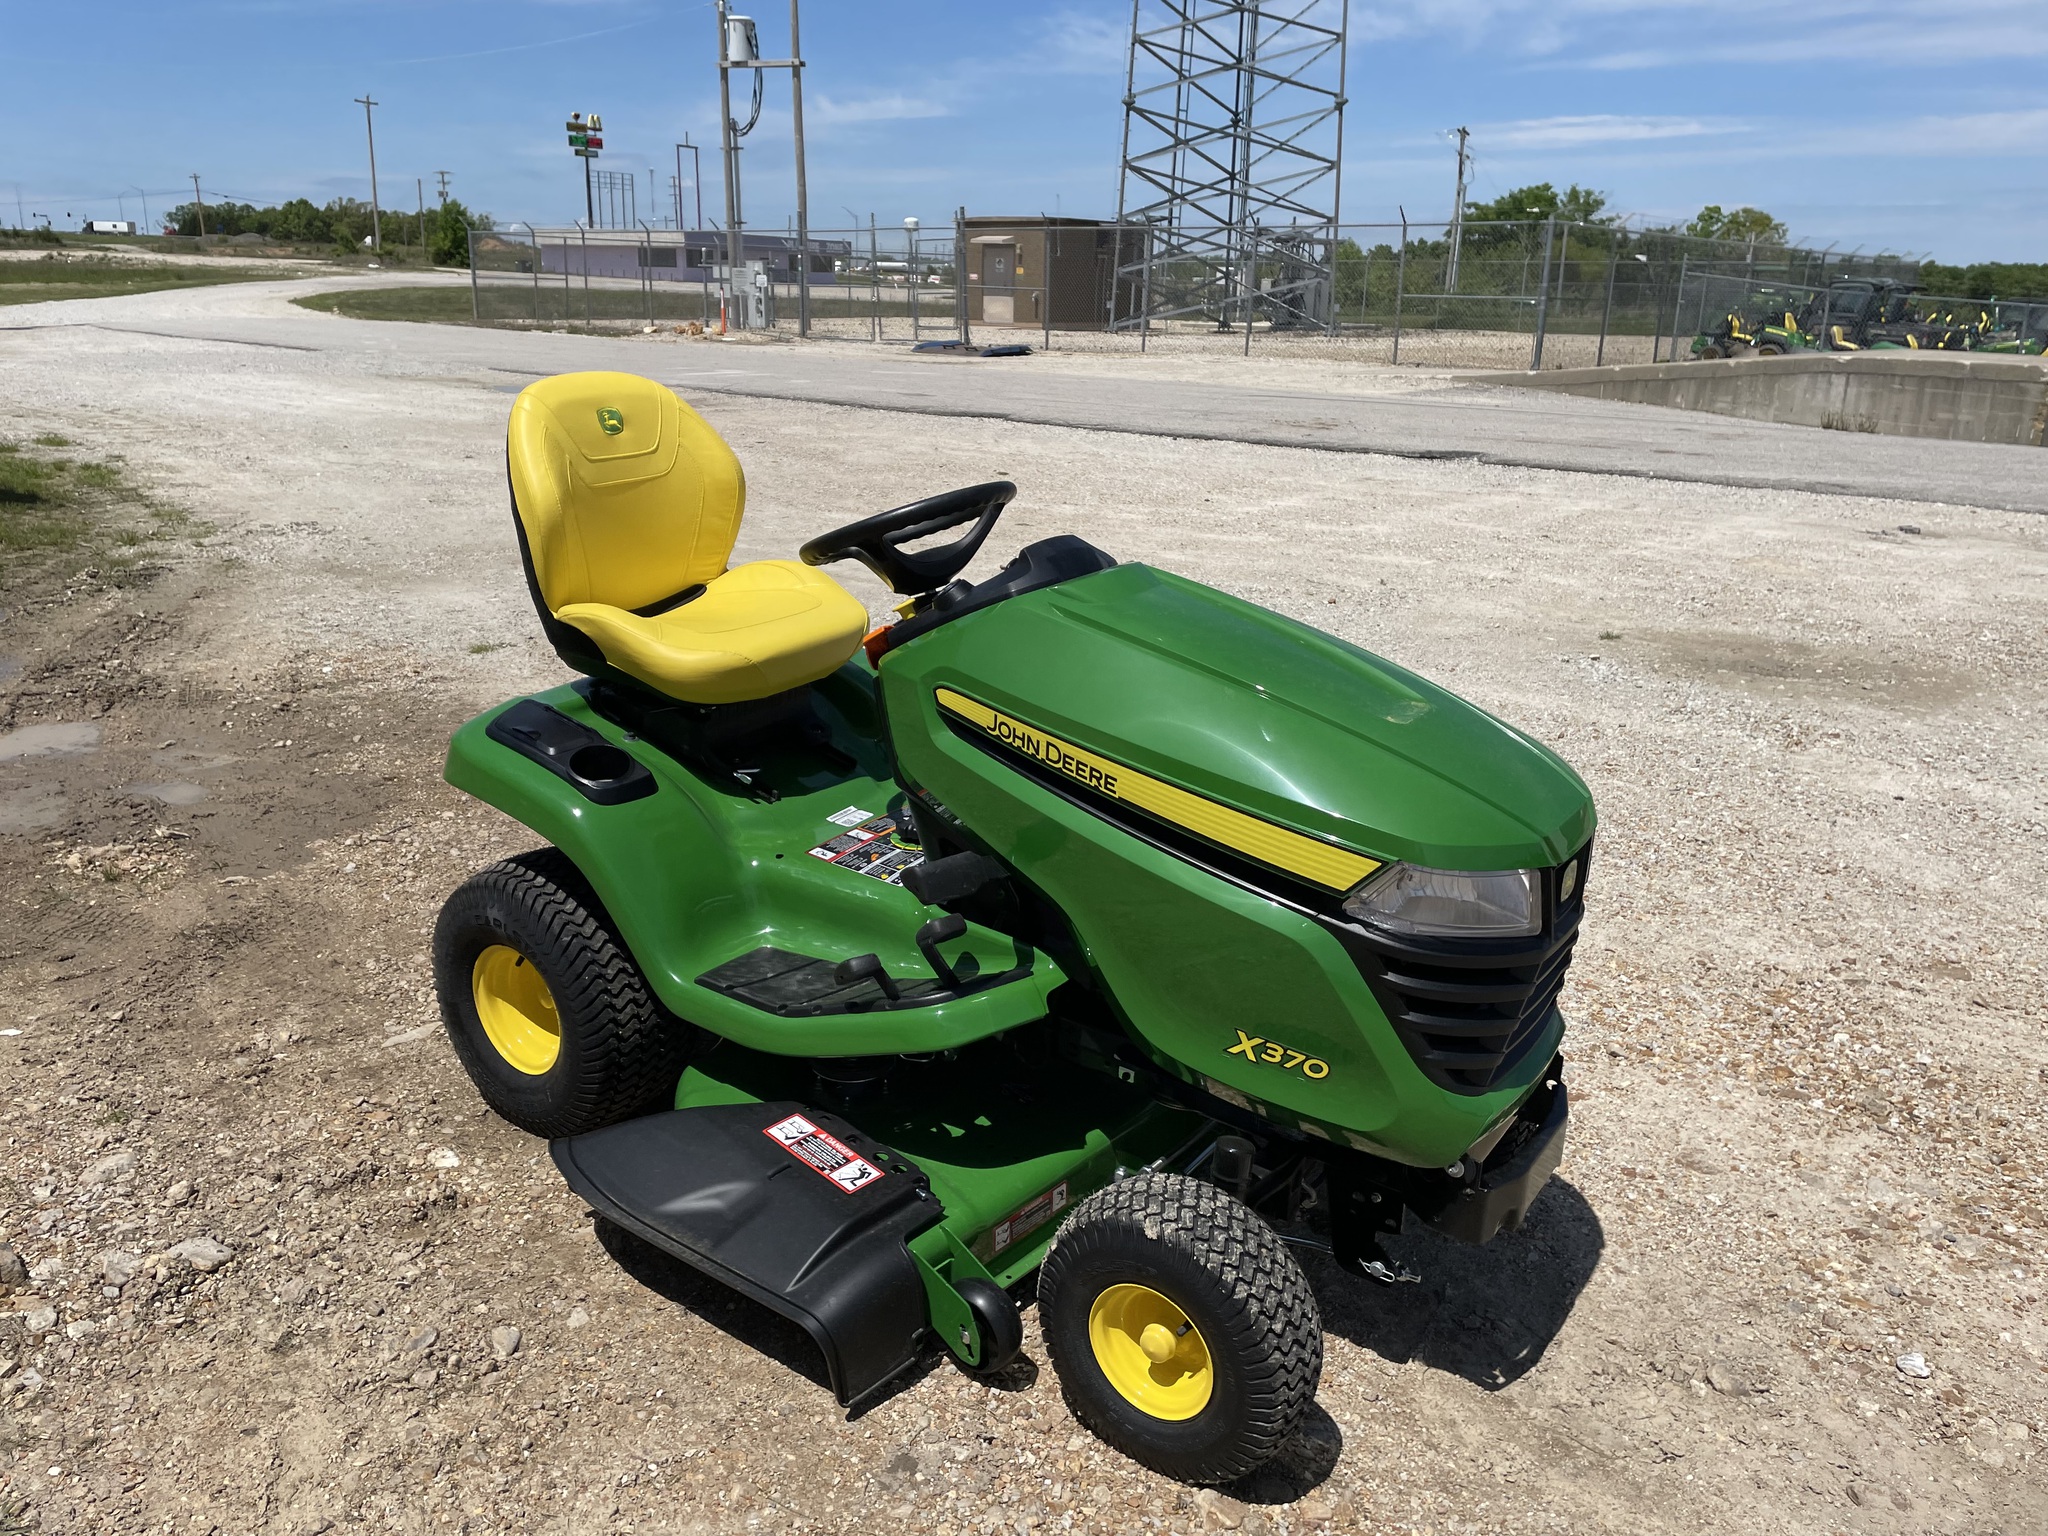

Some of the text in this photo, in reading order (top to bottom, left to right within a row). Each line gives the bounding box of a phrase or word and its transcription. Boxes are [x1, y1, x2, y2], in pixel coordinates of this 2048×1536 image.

[986, 713, 1118, 795] JOHN DEERE
[1225, 1028, 1330, 1080] X370
[825, 1137, 854, 1157] DANGER
